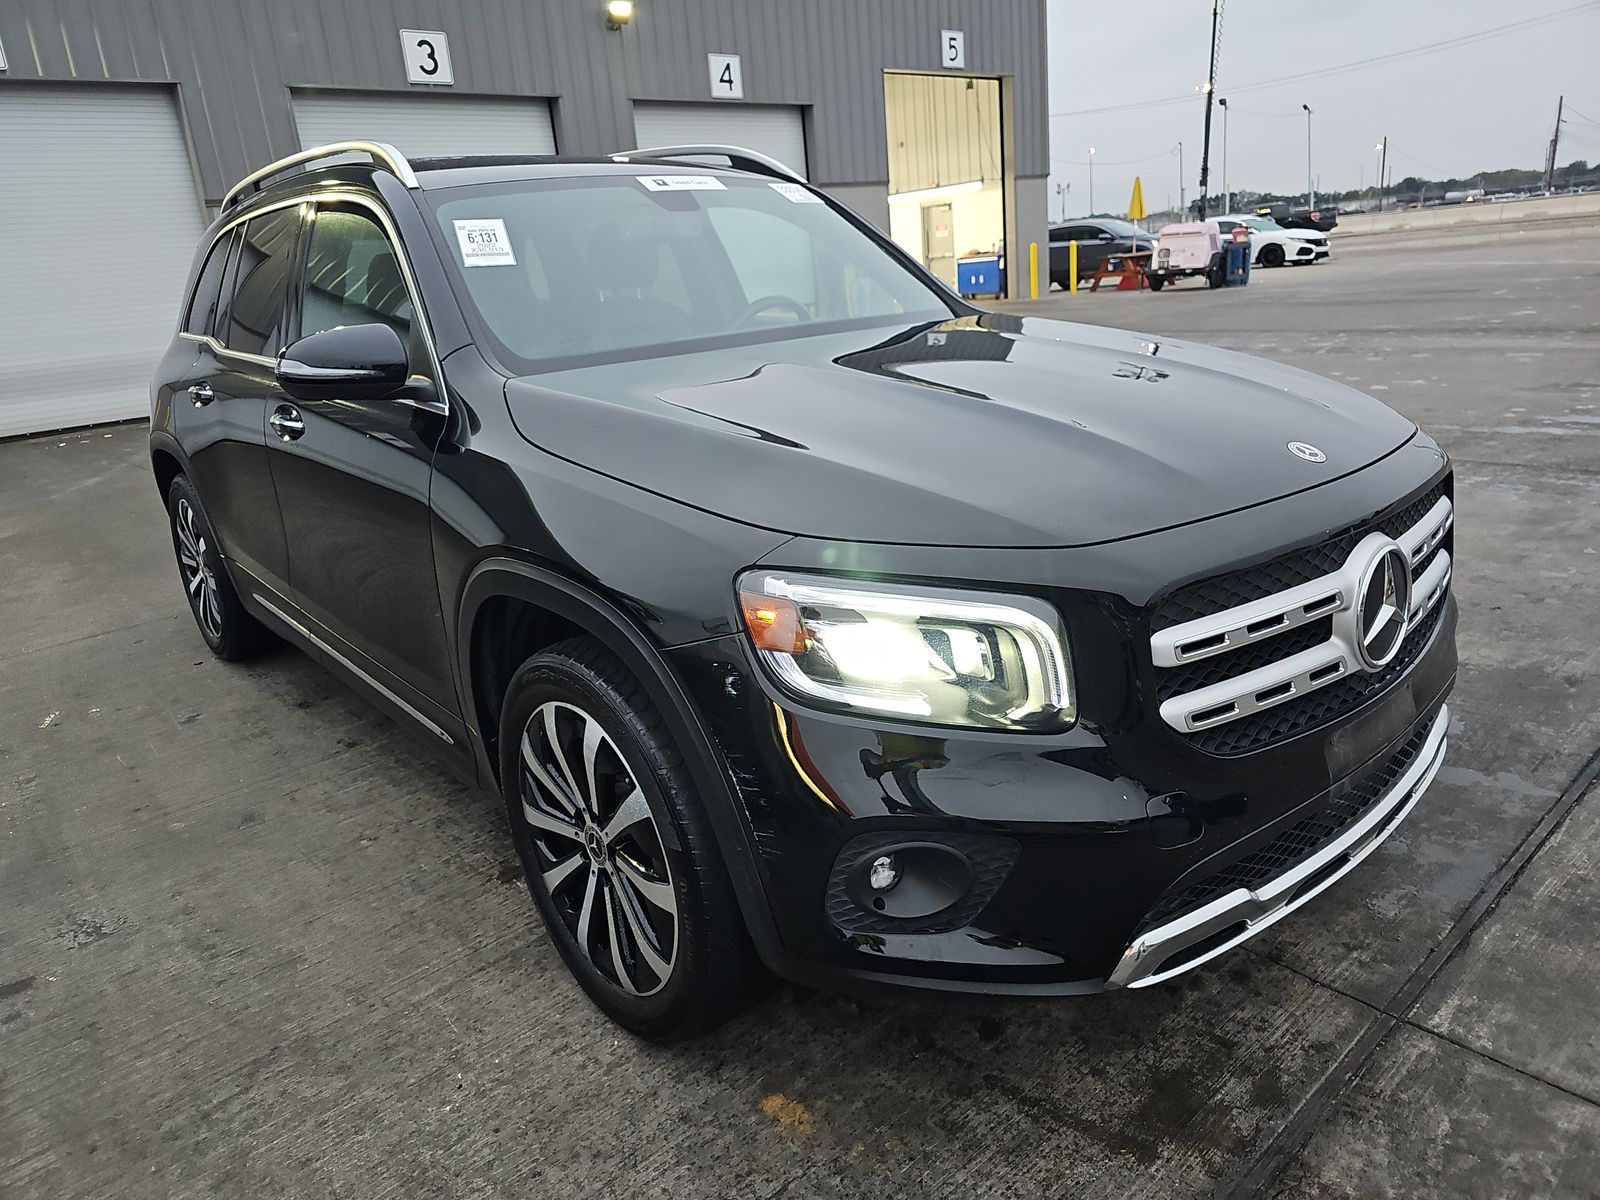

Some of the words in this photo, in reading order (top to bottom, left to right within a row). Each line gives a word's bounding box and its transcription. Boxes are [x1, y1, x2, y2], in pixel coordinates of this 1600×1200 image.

[417, 39, 439, 76] 3
[948, 37, 958, 62] 5
[719, 62, 734, 92] 4
[467, 232, 498, 243] 6:131
